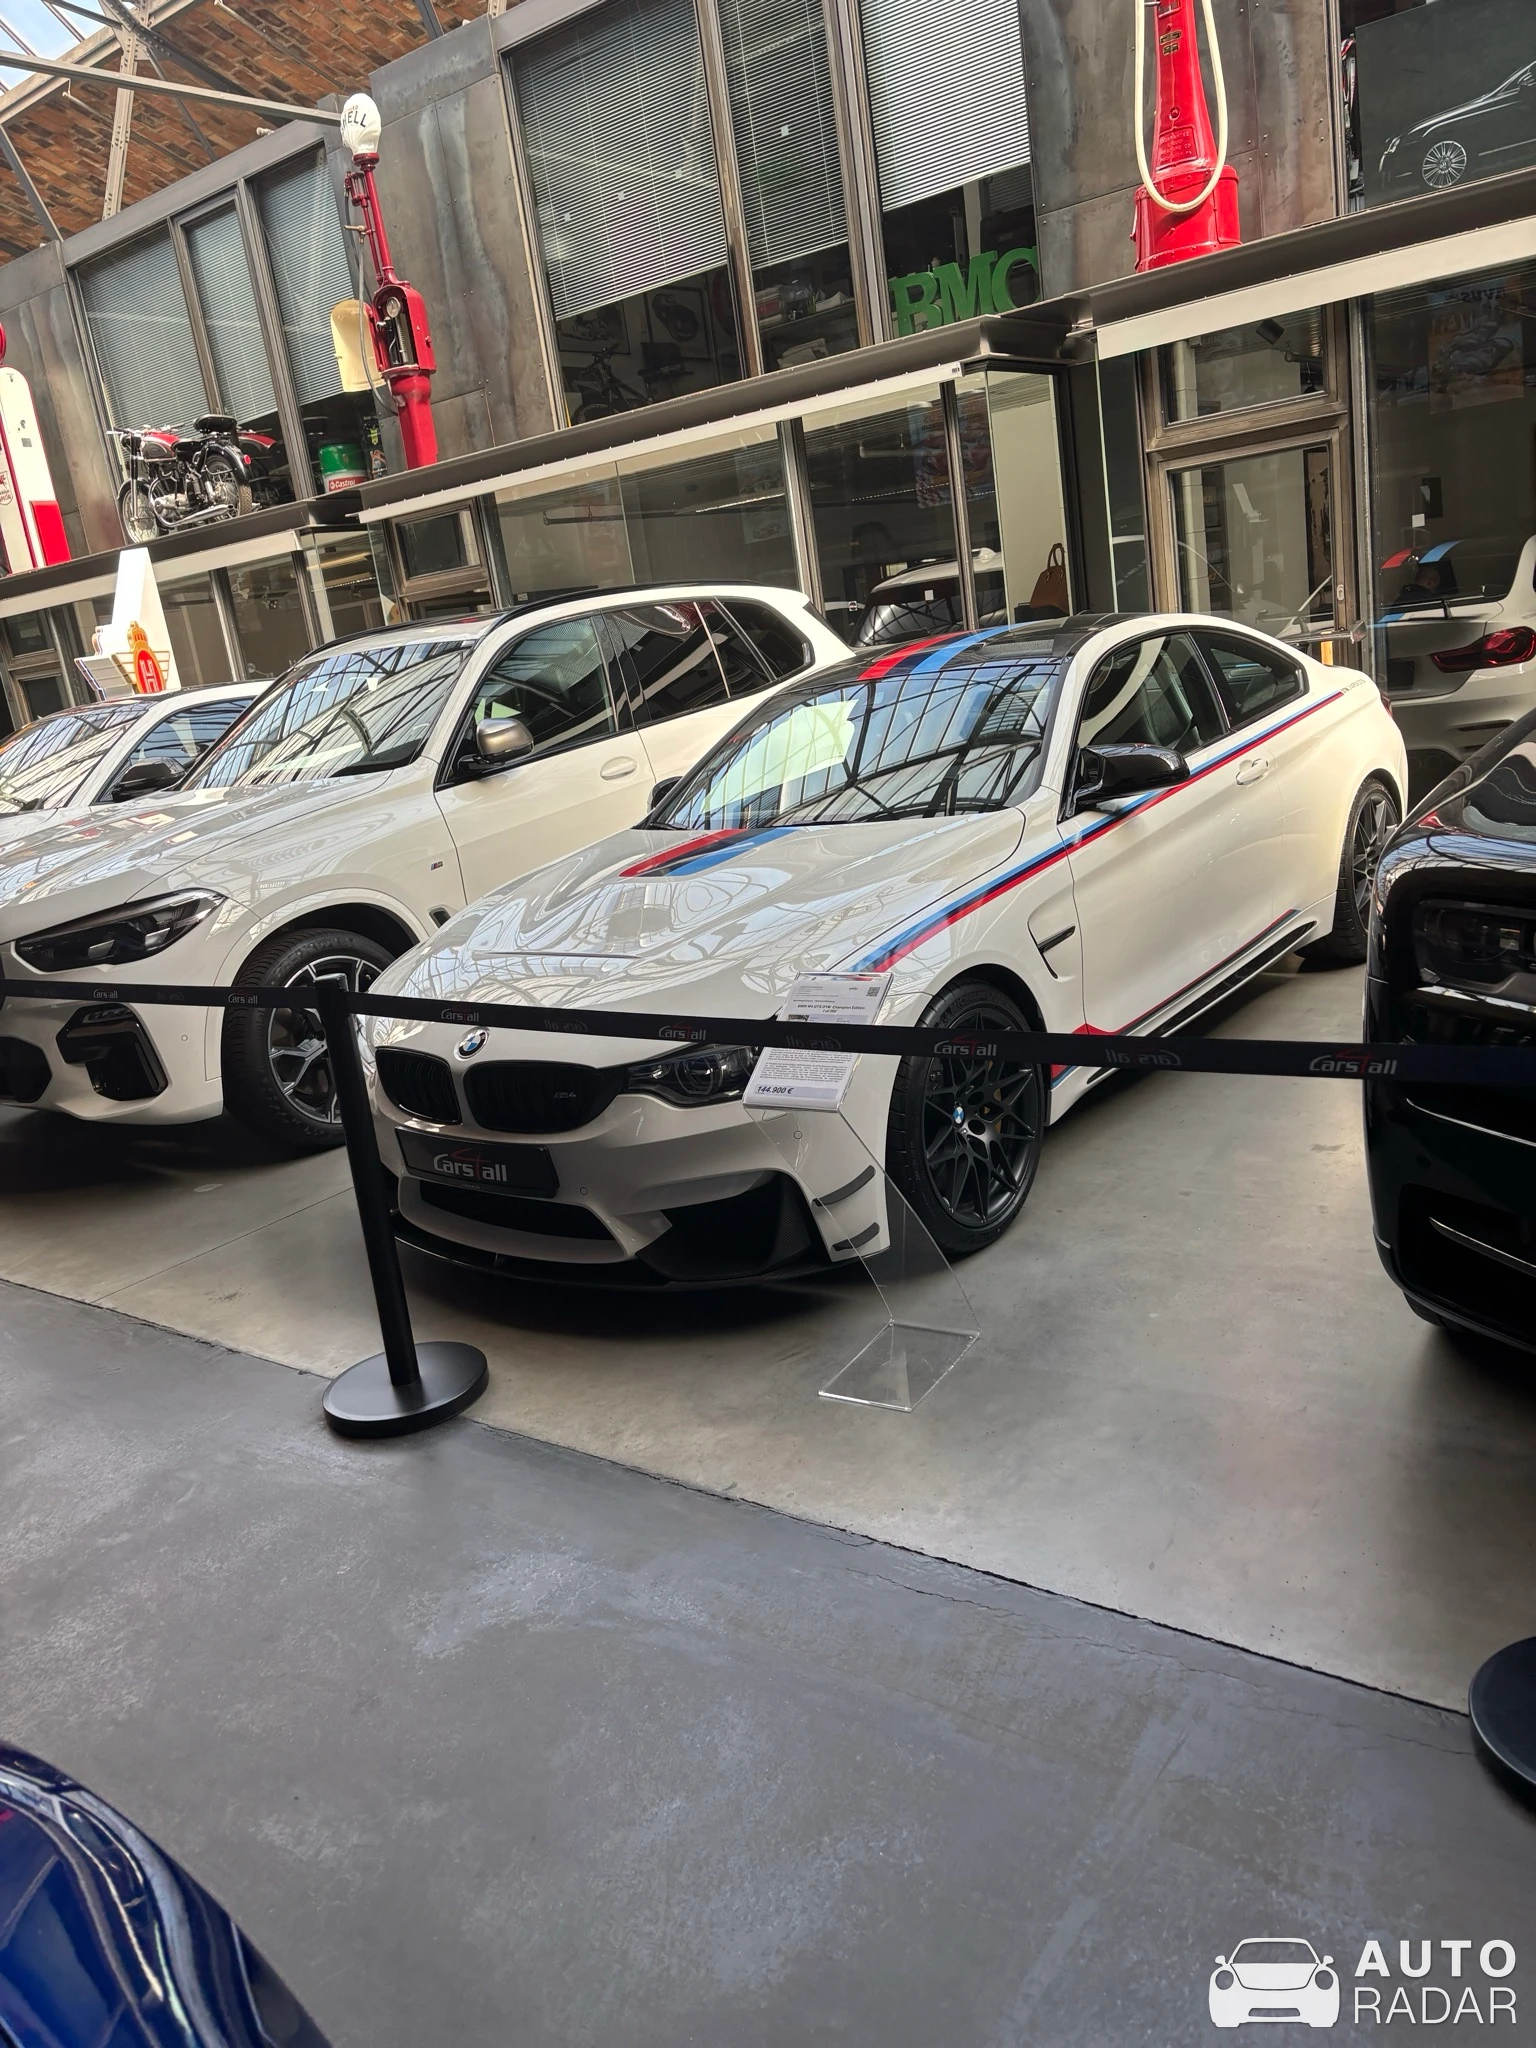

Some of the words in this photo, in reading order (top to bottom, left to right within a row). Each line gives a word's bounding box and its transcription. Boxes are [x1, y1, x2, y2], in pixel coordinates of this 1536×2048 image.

[341, 110, 367, 130] HELL
[888, 246, 1042, 338] BMC
[335, 479, 356, 488] Castrol
[757, 1086, 787, 1094] 144.900
[787, 1087, 794, 1095] €
